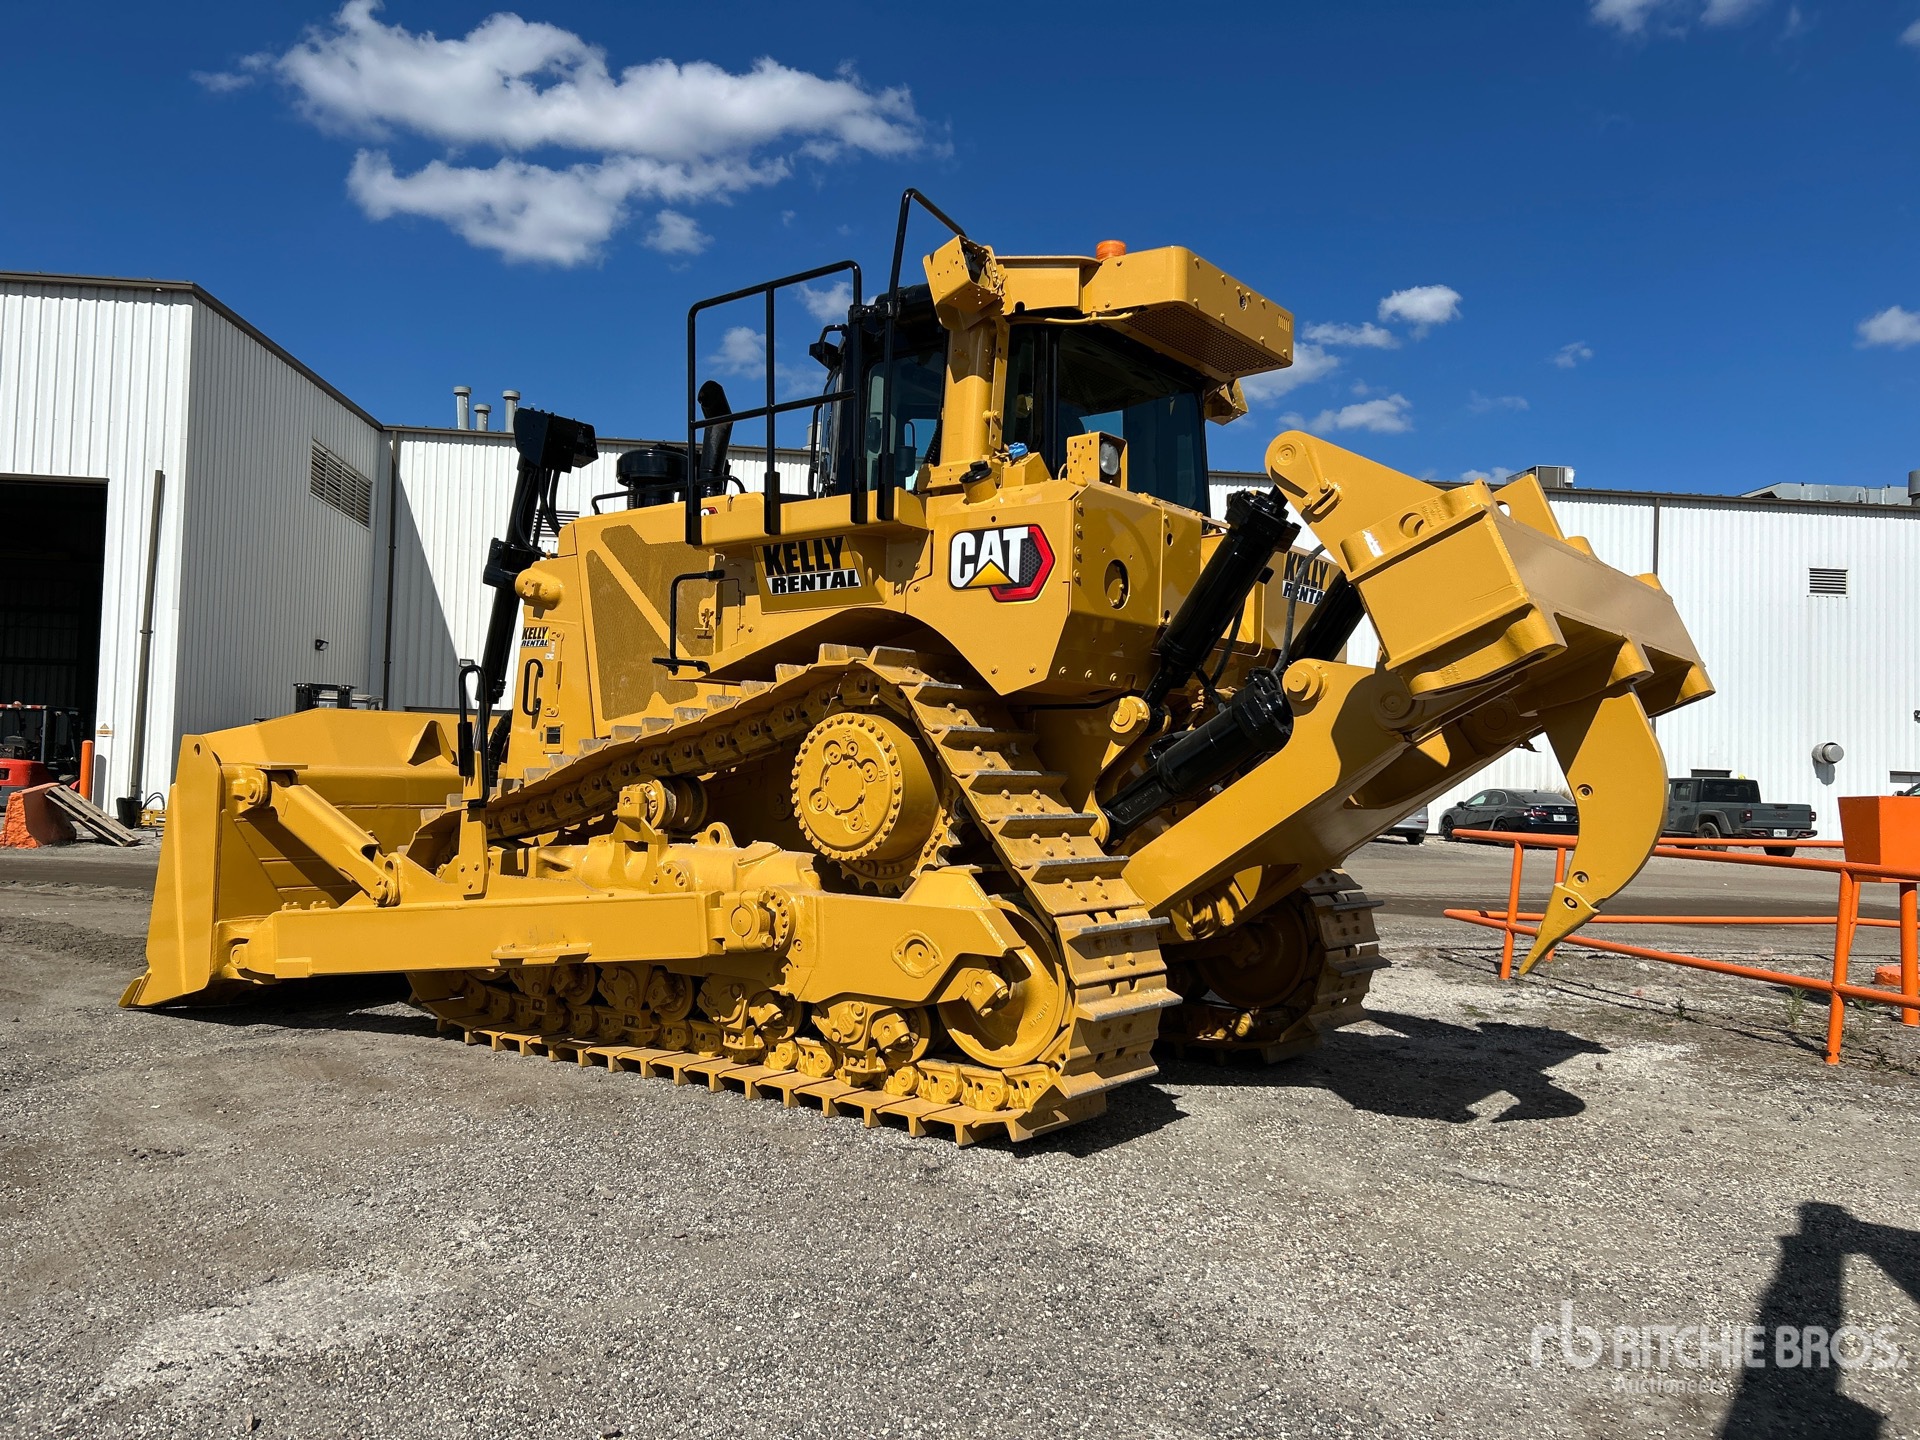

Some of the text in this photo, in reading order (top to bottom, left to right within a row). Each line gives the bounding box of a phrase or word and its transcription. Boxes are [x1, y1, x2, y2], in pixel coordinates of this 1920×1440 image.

[762, 536, 844, 577] KELLY
[950, 526, 1029, 588] CAT
[771, 570, 859, 594] RENTAL
[521, 639, 548, 647] RENTAL
[522, 627, 549, 640] KELLY
